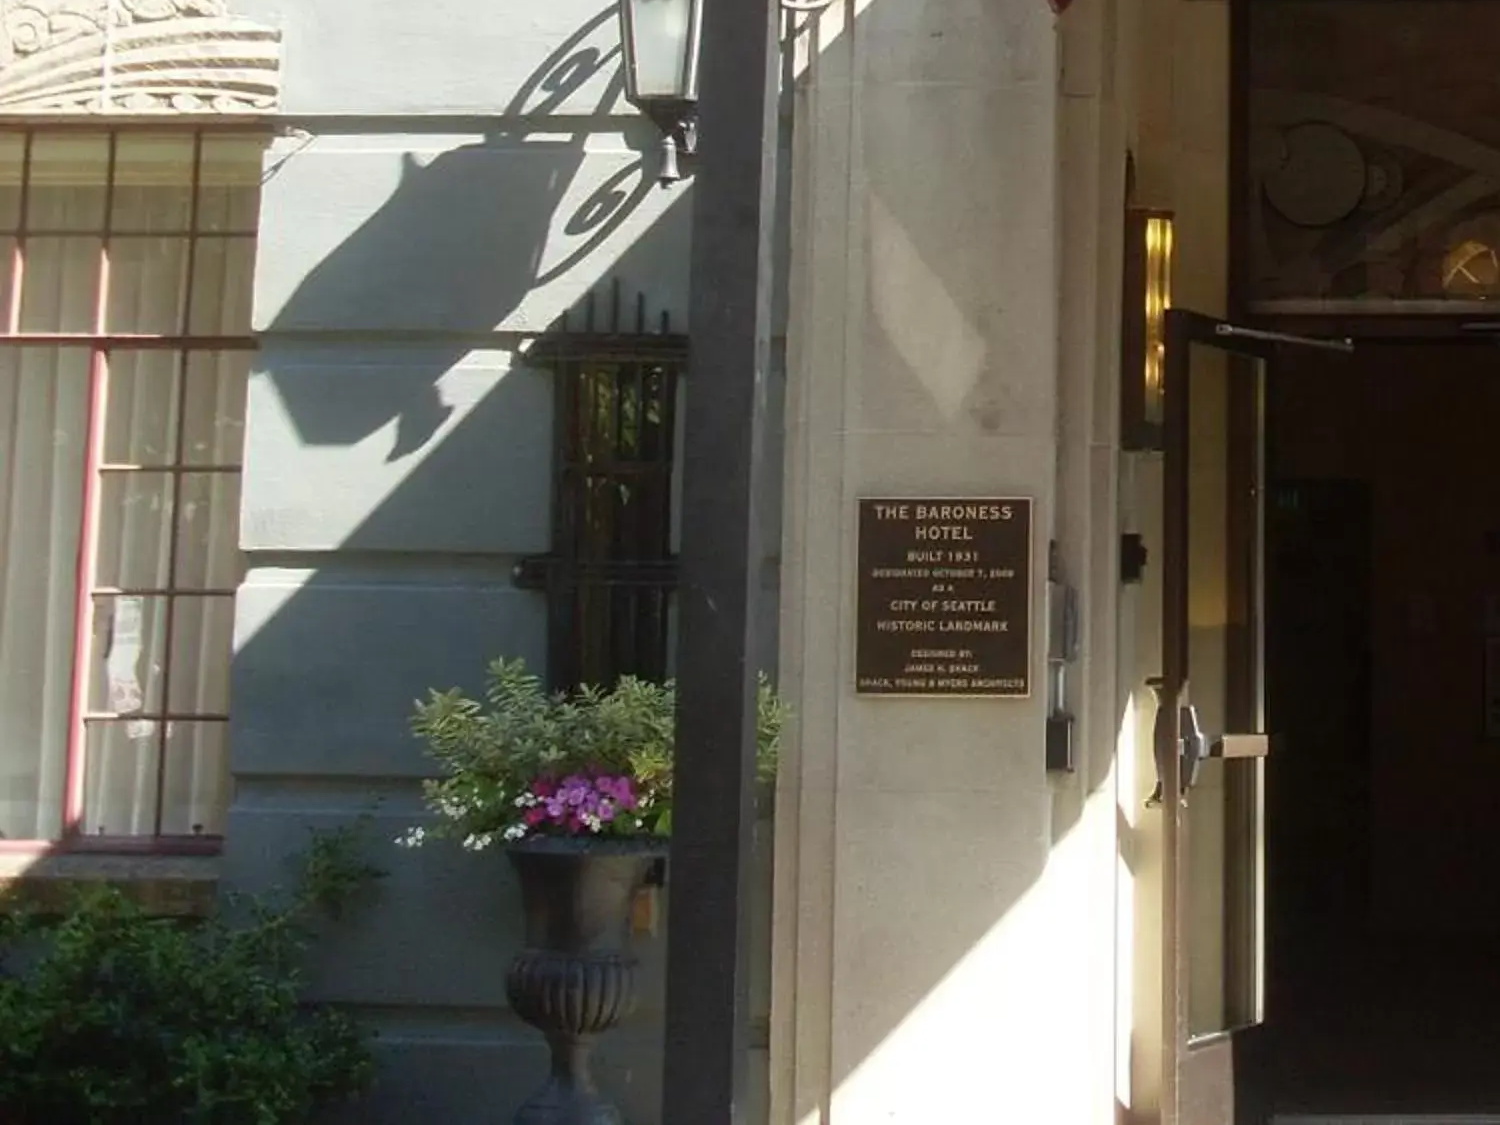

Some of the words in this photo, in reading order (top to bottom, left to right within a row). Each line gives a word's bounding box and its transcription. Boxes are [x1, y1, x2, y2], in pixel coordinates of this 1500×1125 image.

[875, 505, 911, 521] THE
[915, 505, 1013, 521] BARONESS
[915, 526, 974, 541] HOTEL
[906, 551, 943, 563] BUILT
[948, 551, 979, 563] 1931
[890, 600, 918, 613] CITY
[921, 600, 939, 613] OF
[941, 600, 997, 613] SEATTLE
[876, 621, 935, 633] HISTORIC
[938, 621, 1009, 633] LANDMARK
